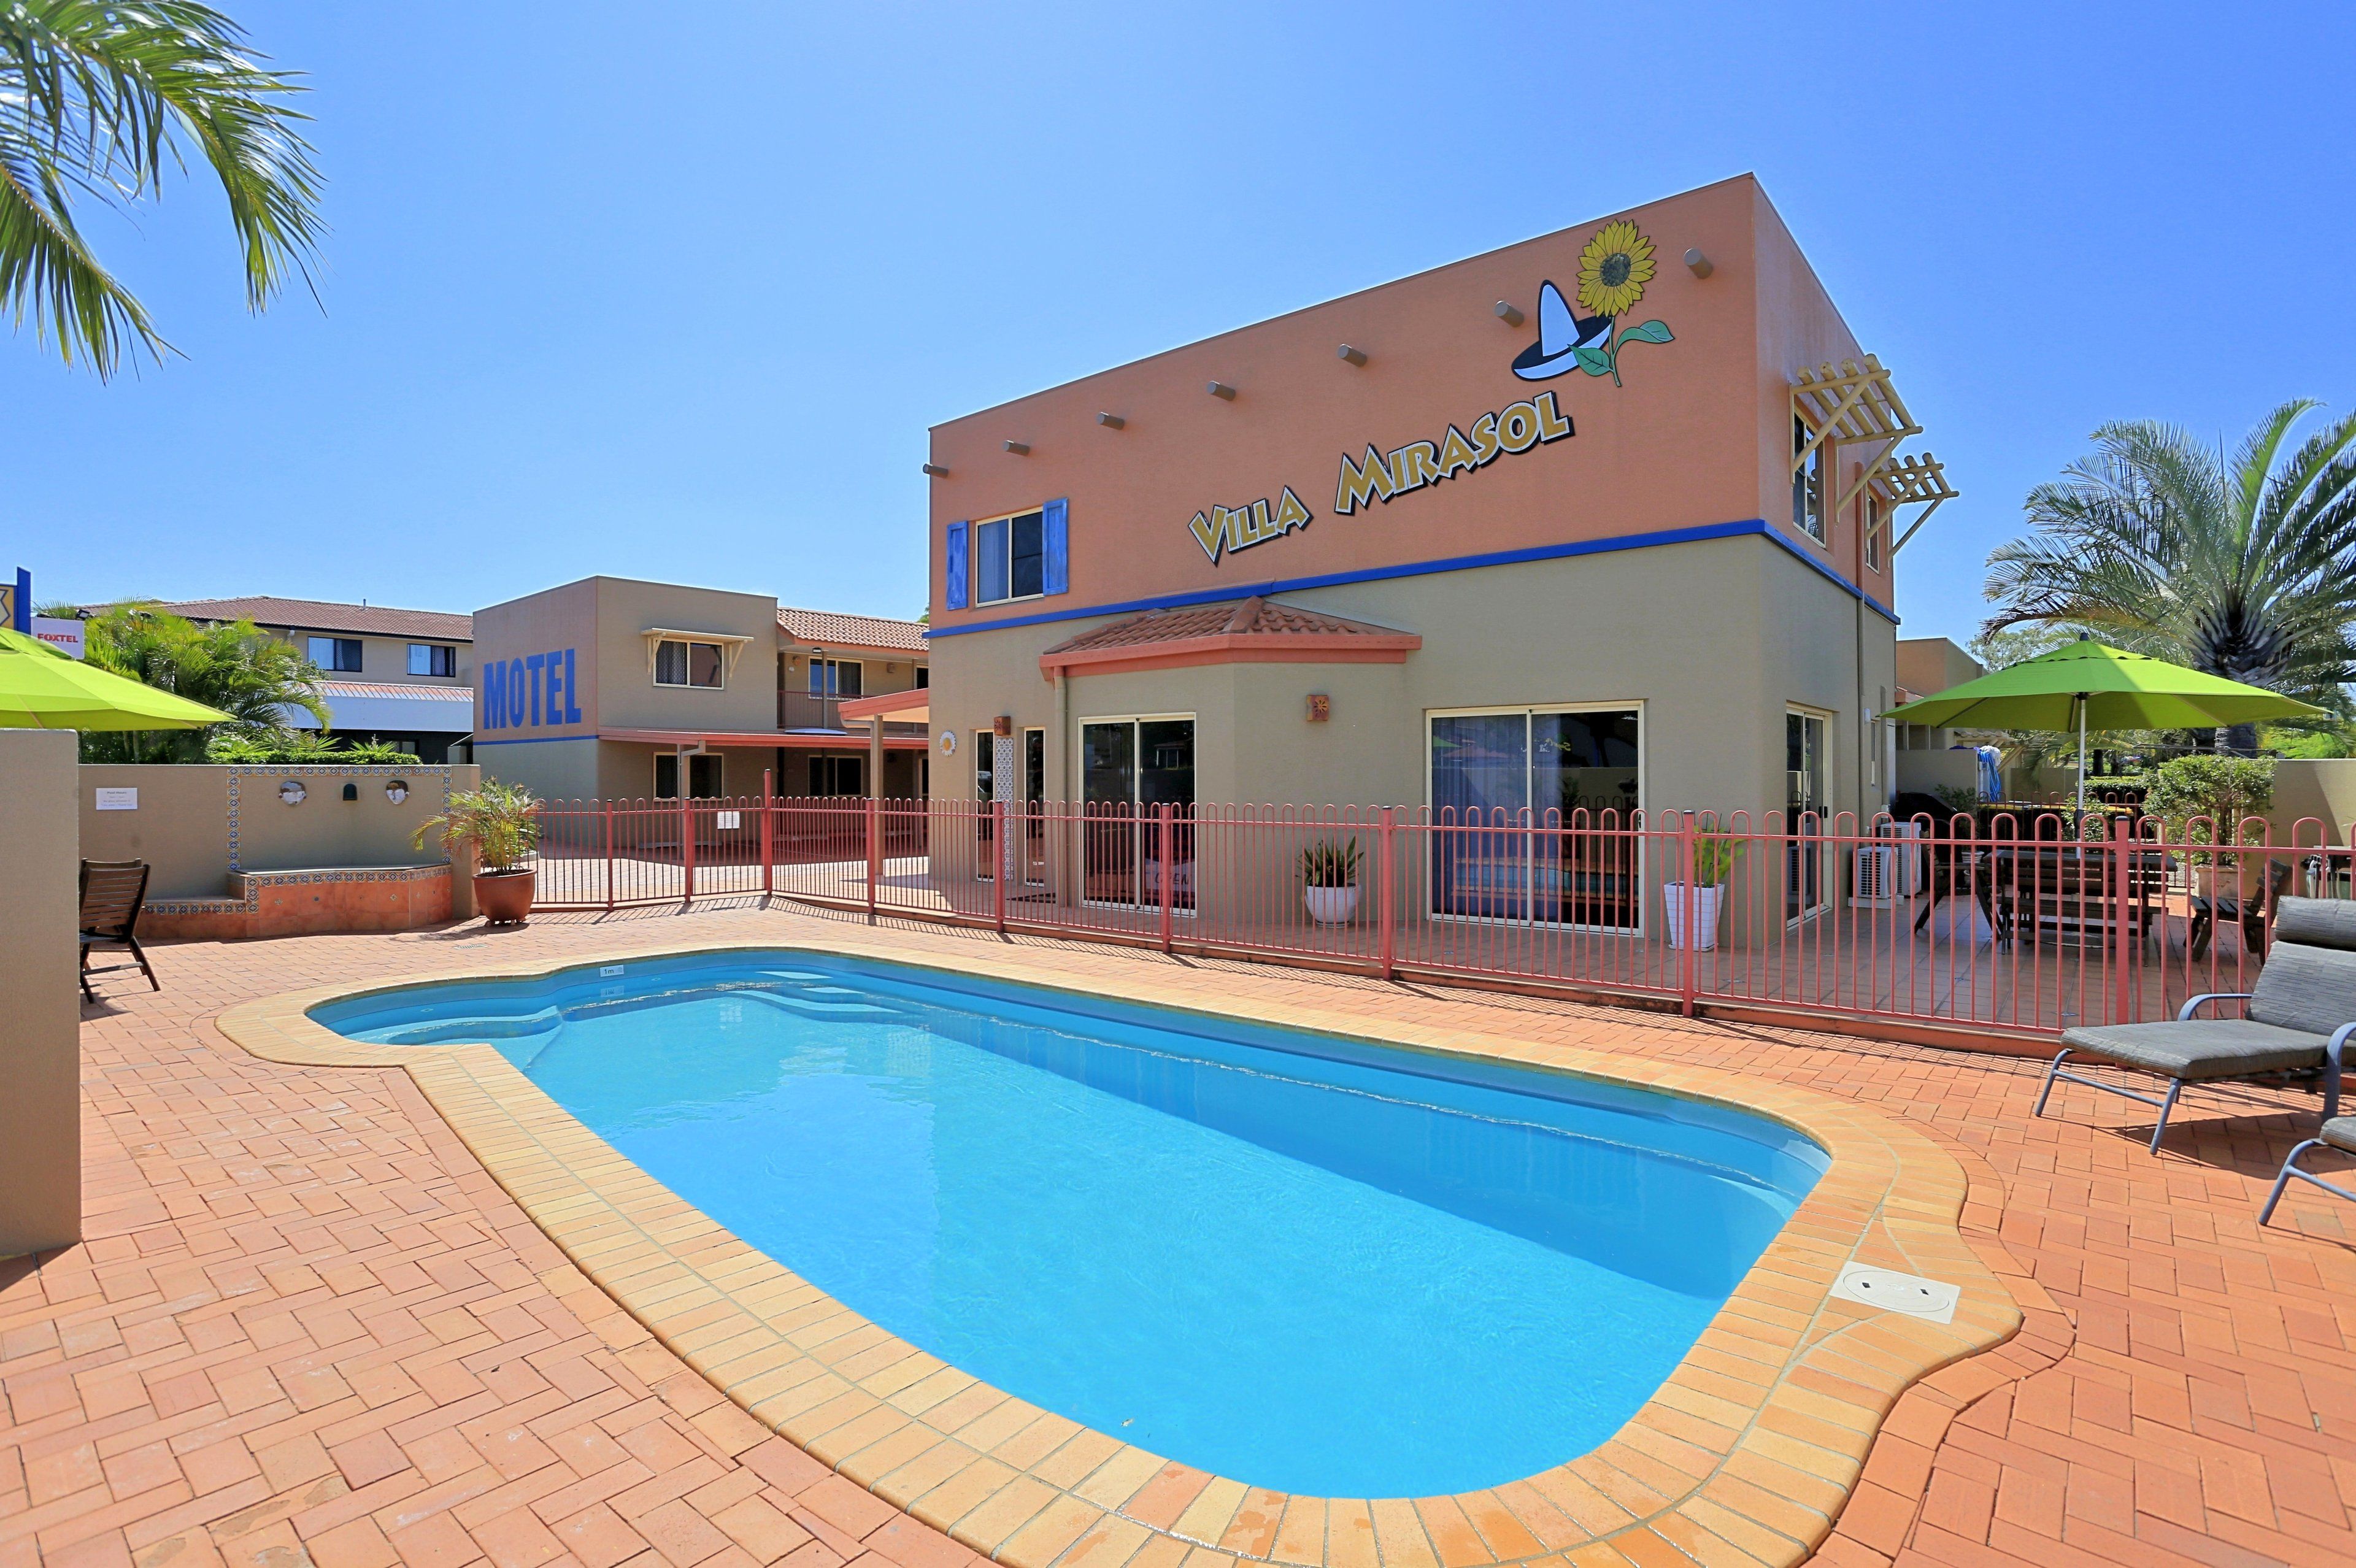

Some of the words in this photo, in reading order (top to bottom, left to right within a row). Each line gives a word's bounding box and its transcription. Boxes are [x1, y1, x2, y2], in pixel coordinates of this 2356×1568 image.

[1188, 485, 1314, 567] VILLA
[1334, 390, 1575, 516] MIRASOL
[37, 633, 79, 643] FOXTEL
[483, 648, 582, 729] MOTEL
